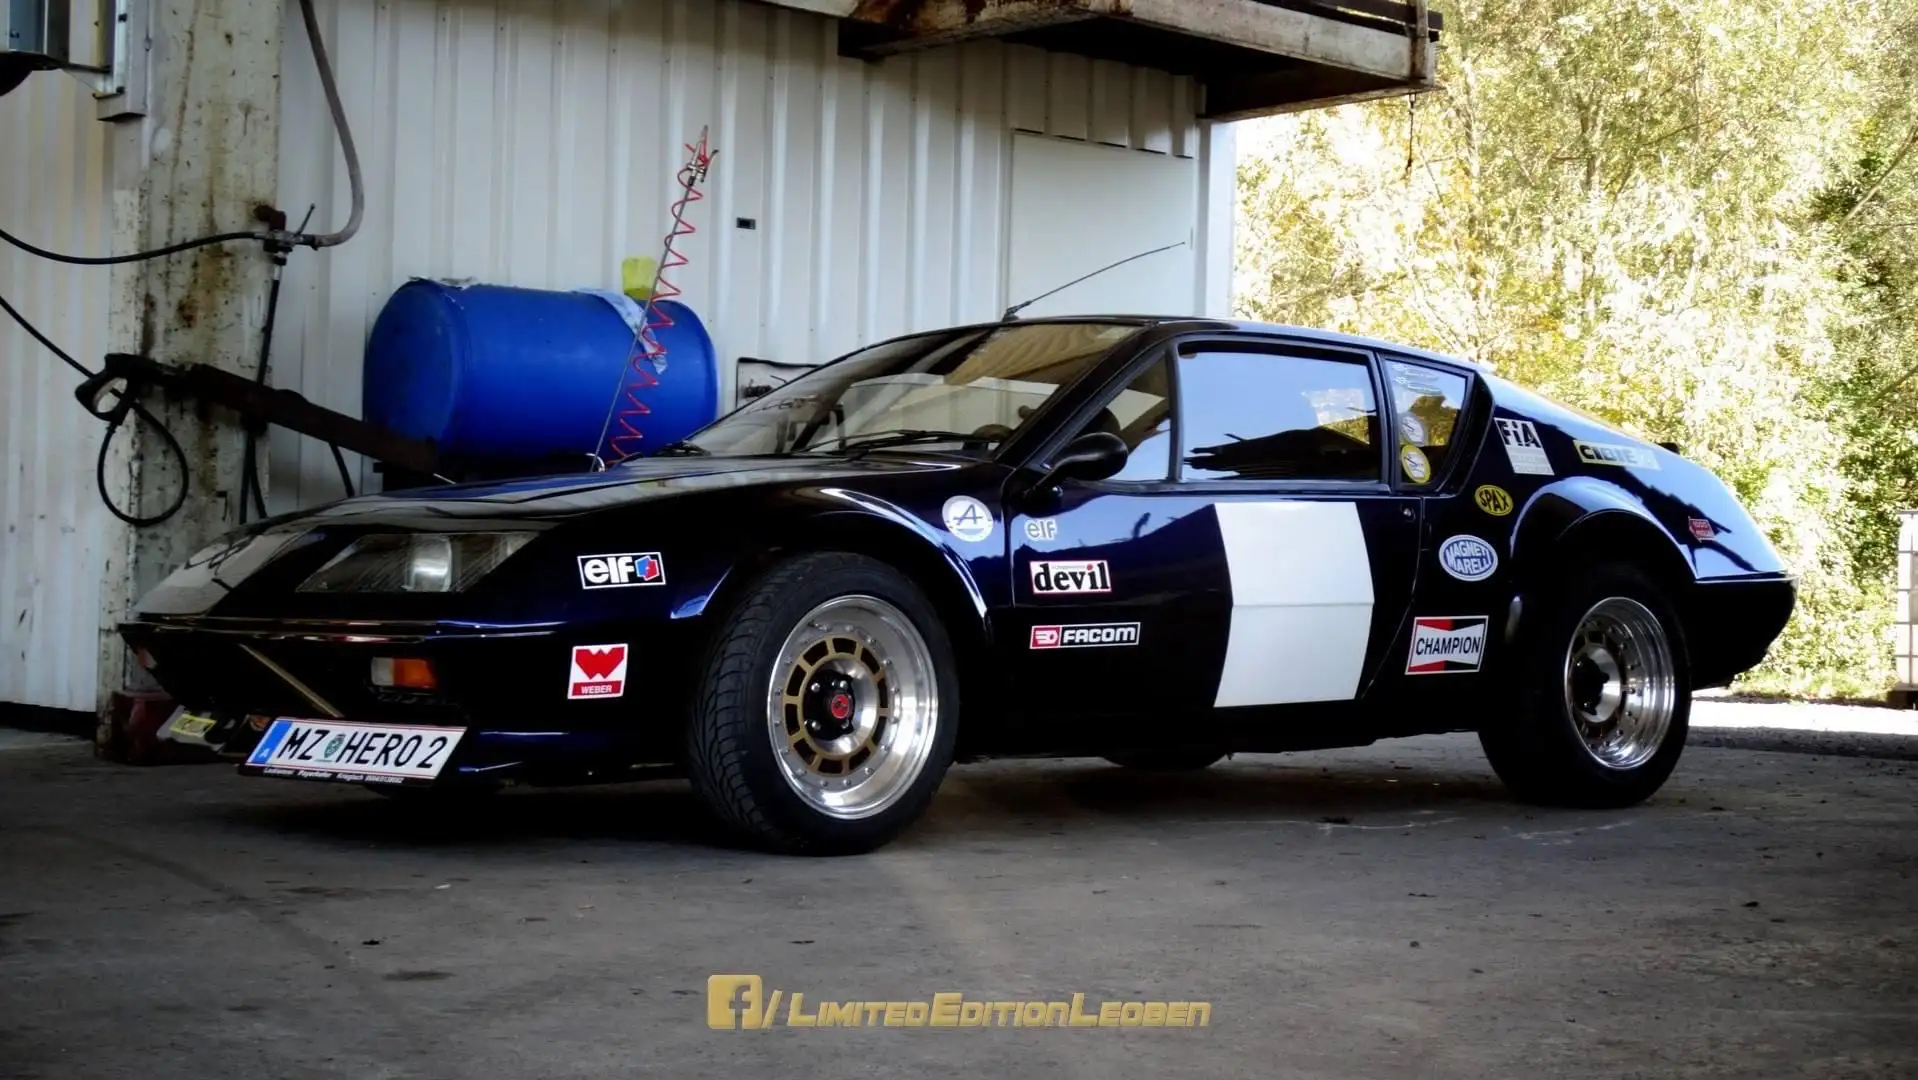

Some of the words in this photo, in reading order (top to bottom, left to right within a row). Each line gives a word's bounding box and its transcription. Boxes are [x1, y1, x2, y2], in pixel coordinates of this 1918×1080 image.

[1479, 488, 1510, 513] SPAX
[1026, 520, 1056, 539] elf
[584, 556, 635, 583] elf
[1034, 562, 1110, 591] devil
[1063, 627, 1136, 643] FACOM
[1416, 636, 1481, 655] CHAMPION
[581, 684, 612, 694] WEBER
[276, 727, 331, 760] MZ
[336, 731, 423, 767] HERO
[416, 736, 448, 768] 2
